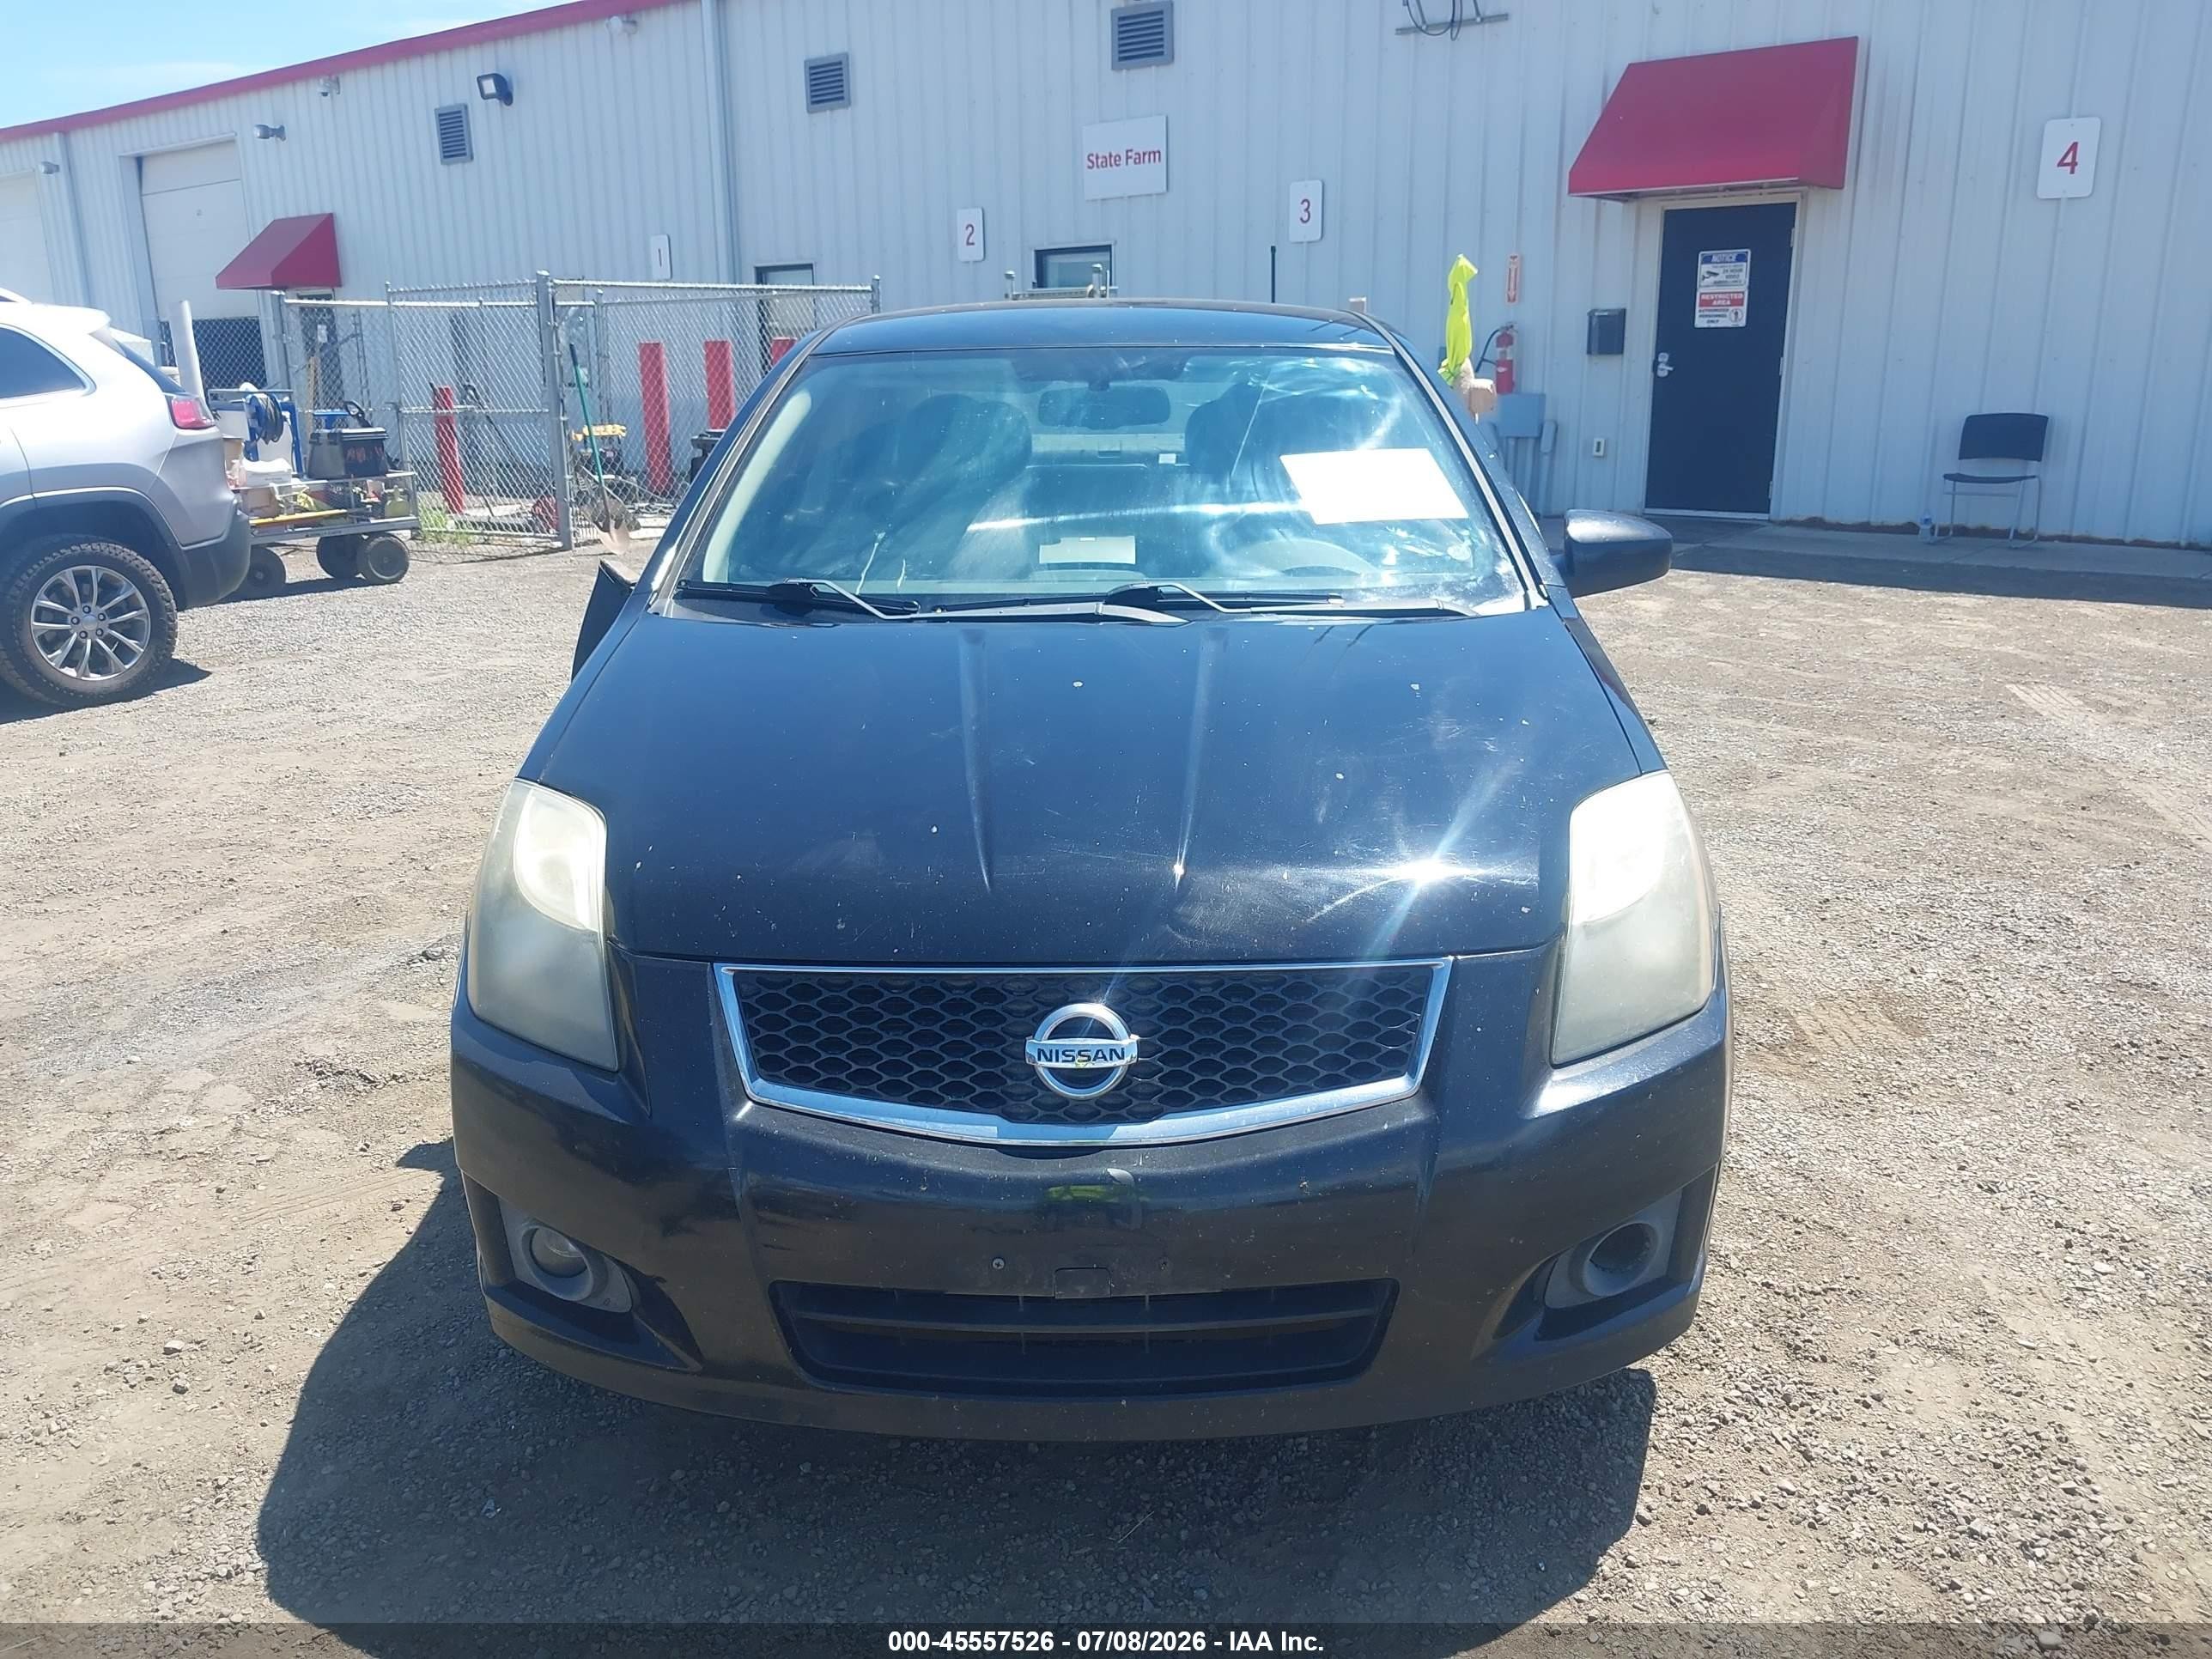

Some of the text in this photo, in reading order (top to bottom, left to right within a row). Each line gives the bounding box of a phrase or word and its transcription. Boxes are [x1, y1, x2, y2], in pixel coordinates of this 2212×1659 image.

[1086, 148, 1162, 170] State Farm
[2057, 141, 2079, 175] 4
[1300, 198, 1311, 224] 3
[965, 223, 975, 246] 2
[1711, 253, 1738, 262] NOTICE
[1036, 1048, 1125, 1063] NISSAN
